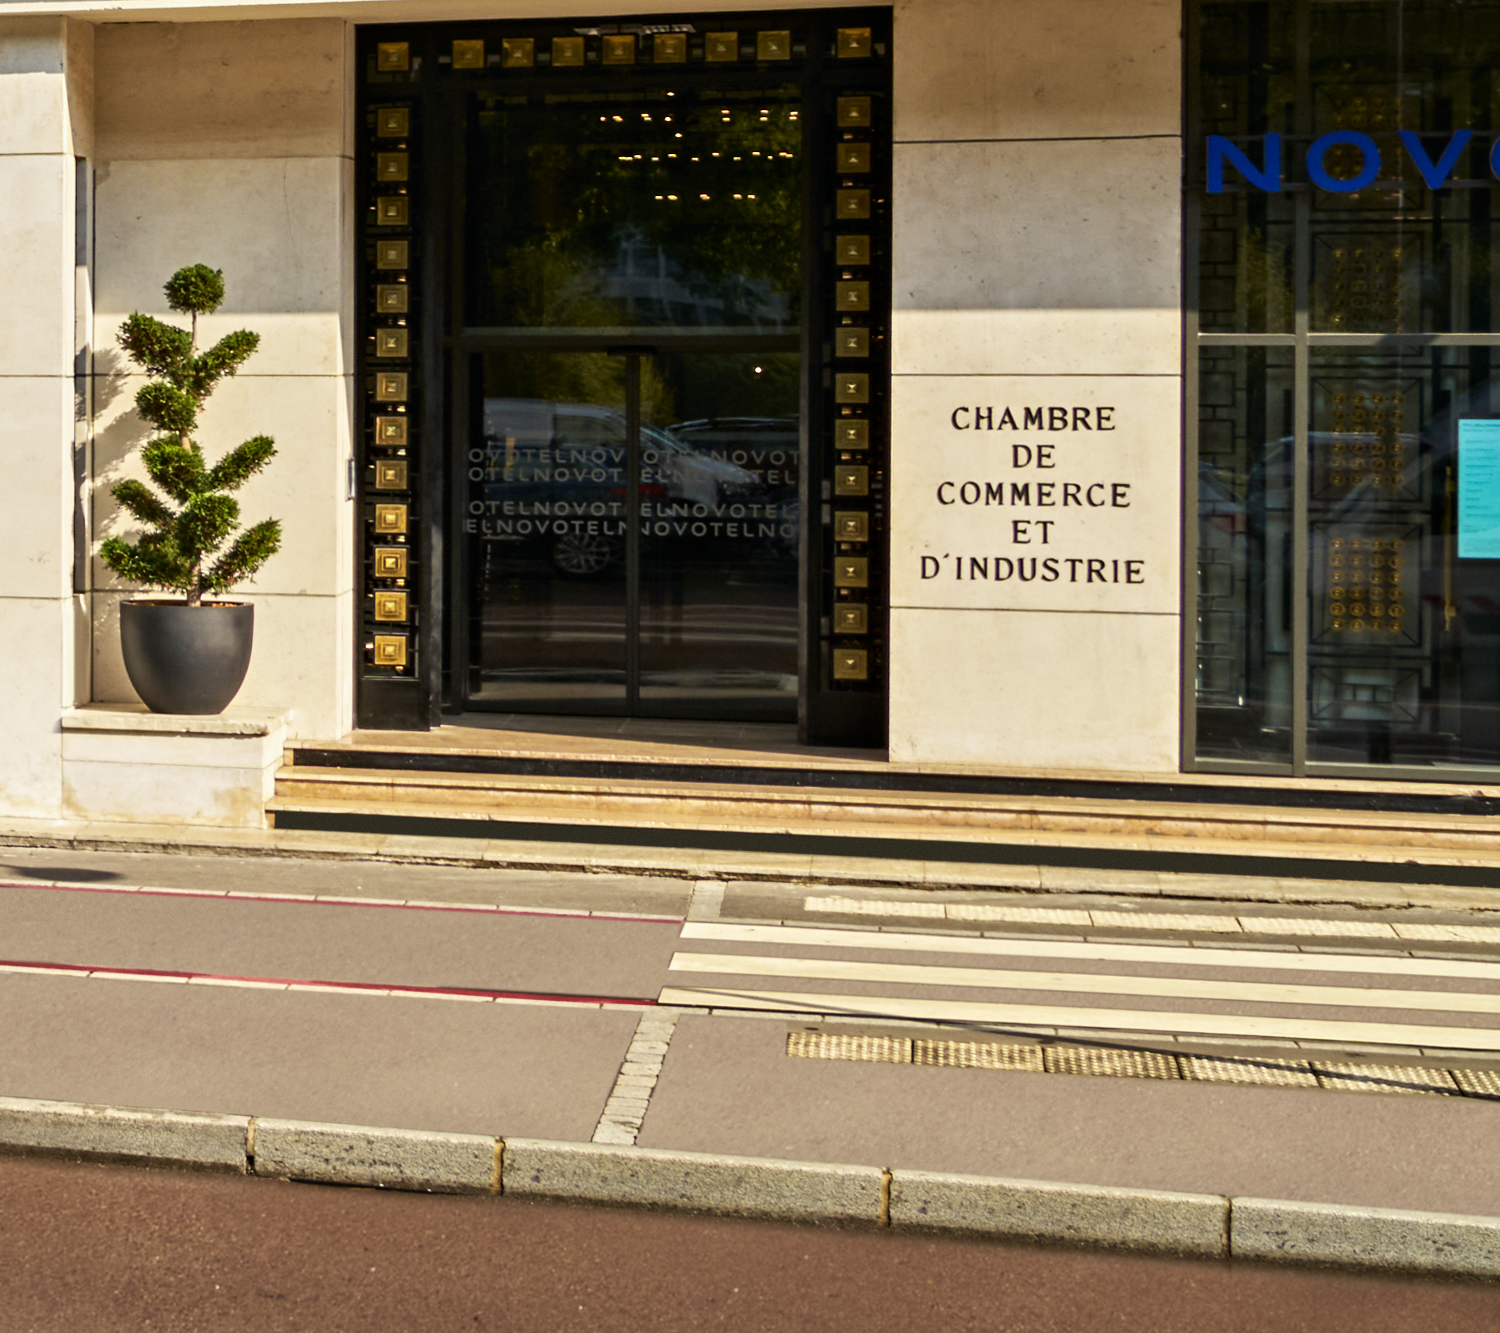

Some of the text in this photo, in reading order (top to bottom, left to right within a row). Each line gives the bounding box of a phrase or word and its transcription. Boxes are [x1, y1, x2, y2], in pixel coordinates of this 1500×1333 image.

[1206, 129, 1500, 193] NOV
[951, 406, 1116, 432] CHAMBRE
[468, 448, 625, 464] OVOTELNOV
[1012, 444, 1056, 469] DE
[468, 467, 623, 482] OTELNOVOT
[936, 481, 1131, 508] COMMERCE
[469, 500, 795, 519] OTELNOVOT ELNOVOTEL
[1012, 519, 1055, 544] ET
[920, 553, 1145, 584] D'INDUSTRIE
